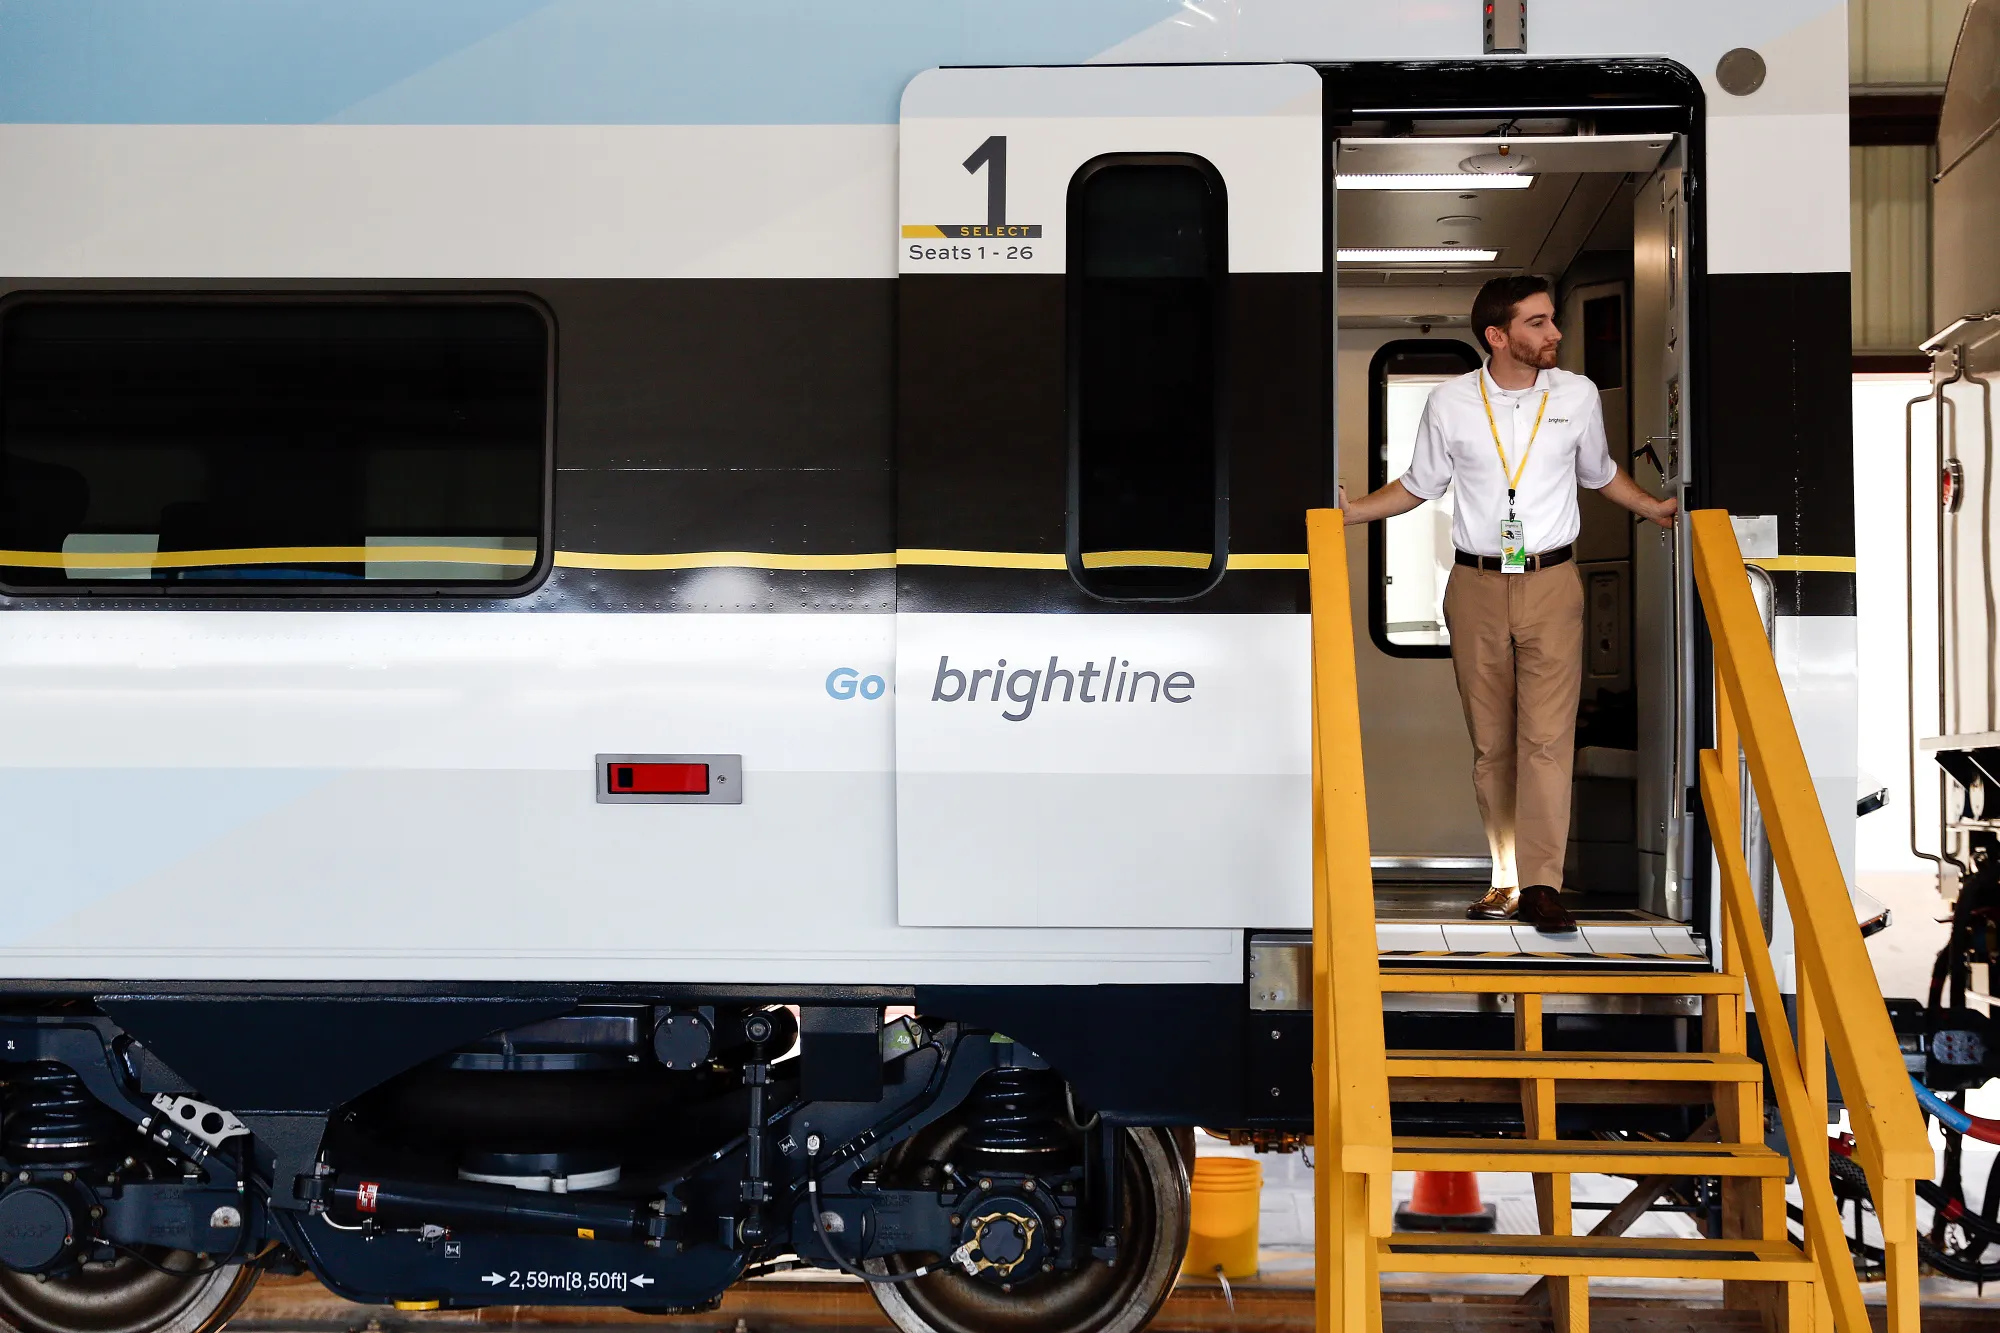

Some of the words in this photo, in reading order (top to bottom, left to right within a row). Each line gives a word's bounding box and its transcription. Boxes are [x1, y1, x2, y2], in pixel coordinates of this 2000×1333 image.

[962, 136, 1007, 226] 1
[960, 226, 1030, 237] SELECT
[909, 244, 972, 261] Seats
[1006, 246, 1034, 261] 26
[825, 667, 886, 701] Go
[931, 655, 1196, 722] brightline
[508, 1270, 628, 1292] 2,59m[8,50ft]
